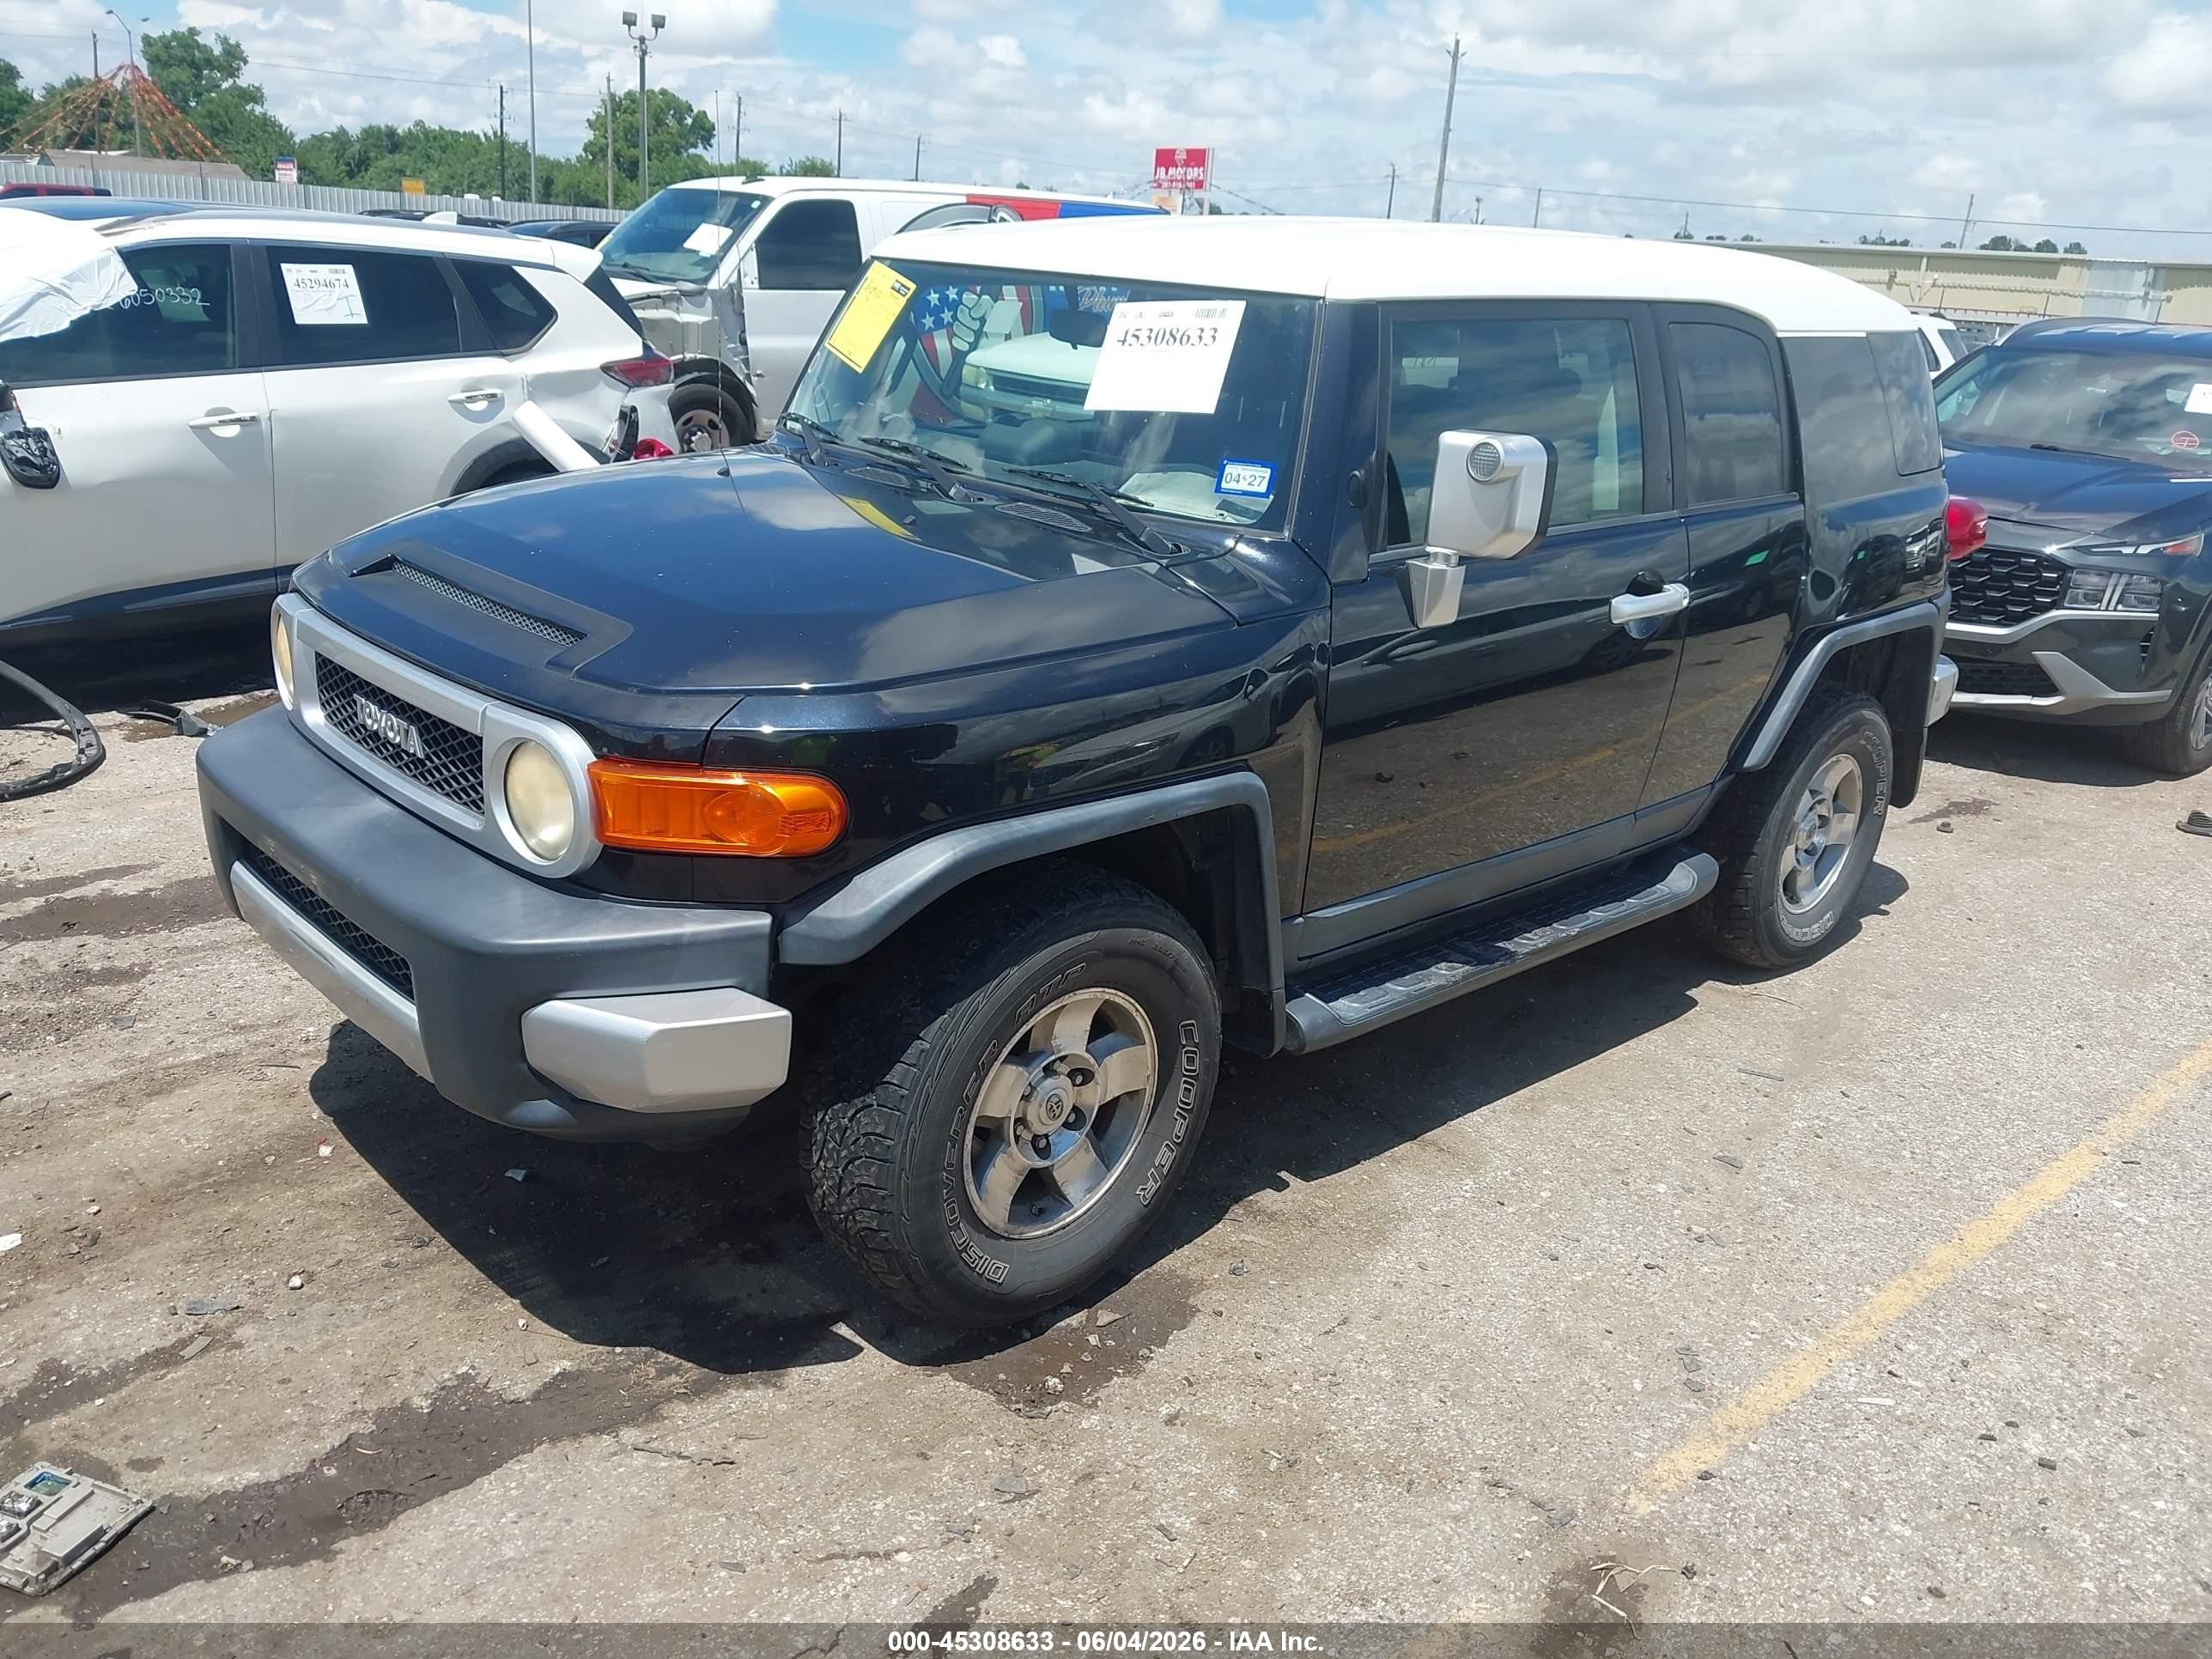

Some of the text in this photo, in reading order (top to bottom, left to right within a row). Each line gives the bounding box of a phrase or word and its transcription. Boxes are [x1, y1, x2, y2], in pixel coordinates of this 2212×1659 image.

[1168, 166, 1204, 180] MOTORS
[294, 277, 349, 289] 45294674
[1116, 326, 1218, 346] 45308633
[1224, 472, 1267, 488] 04 27
[353, 693, 424, 759] TOYOTA
[1135, 1019, 1200, 1206] COOPER
[942, 962, 1086, 1284] DISCOVERER ATP
